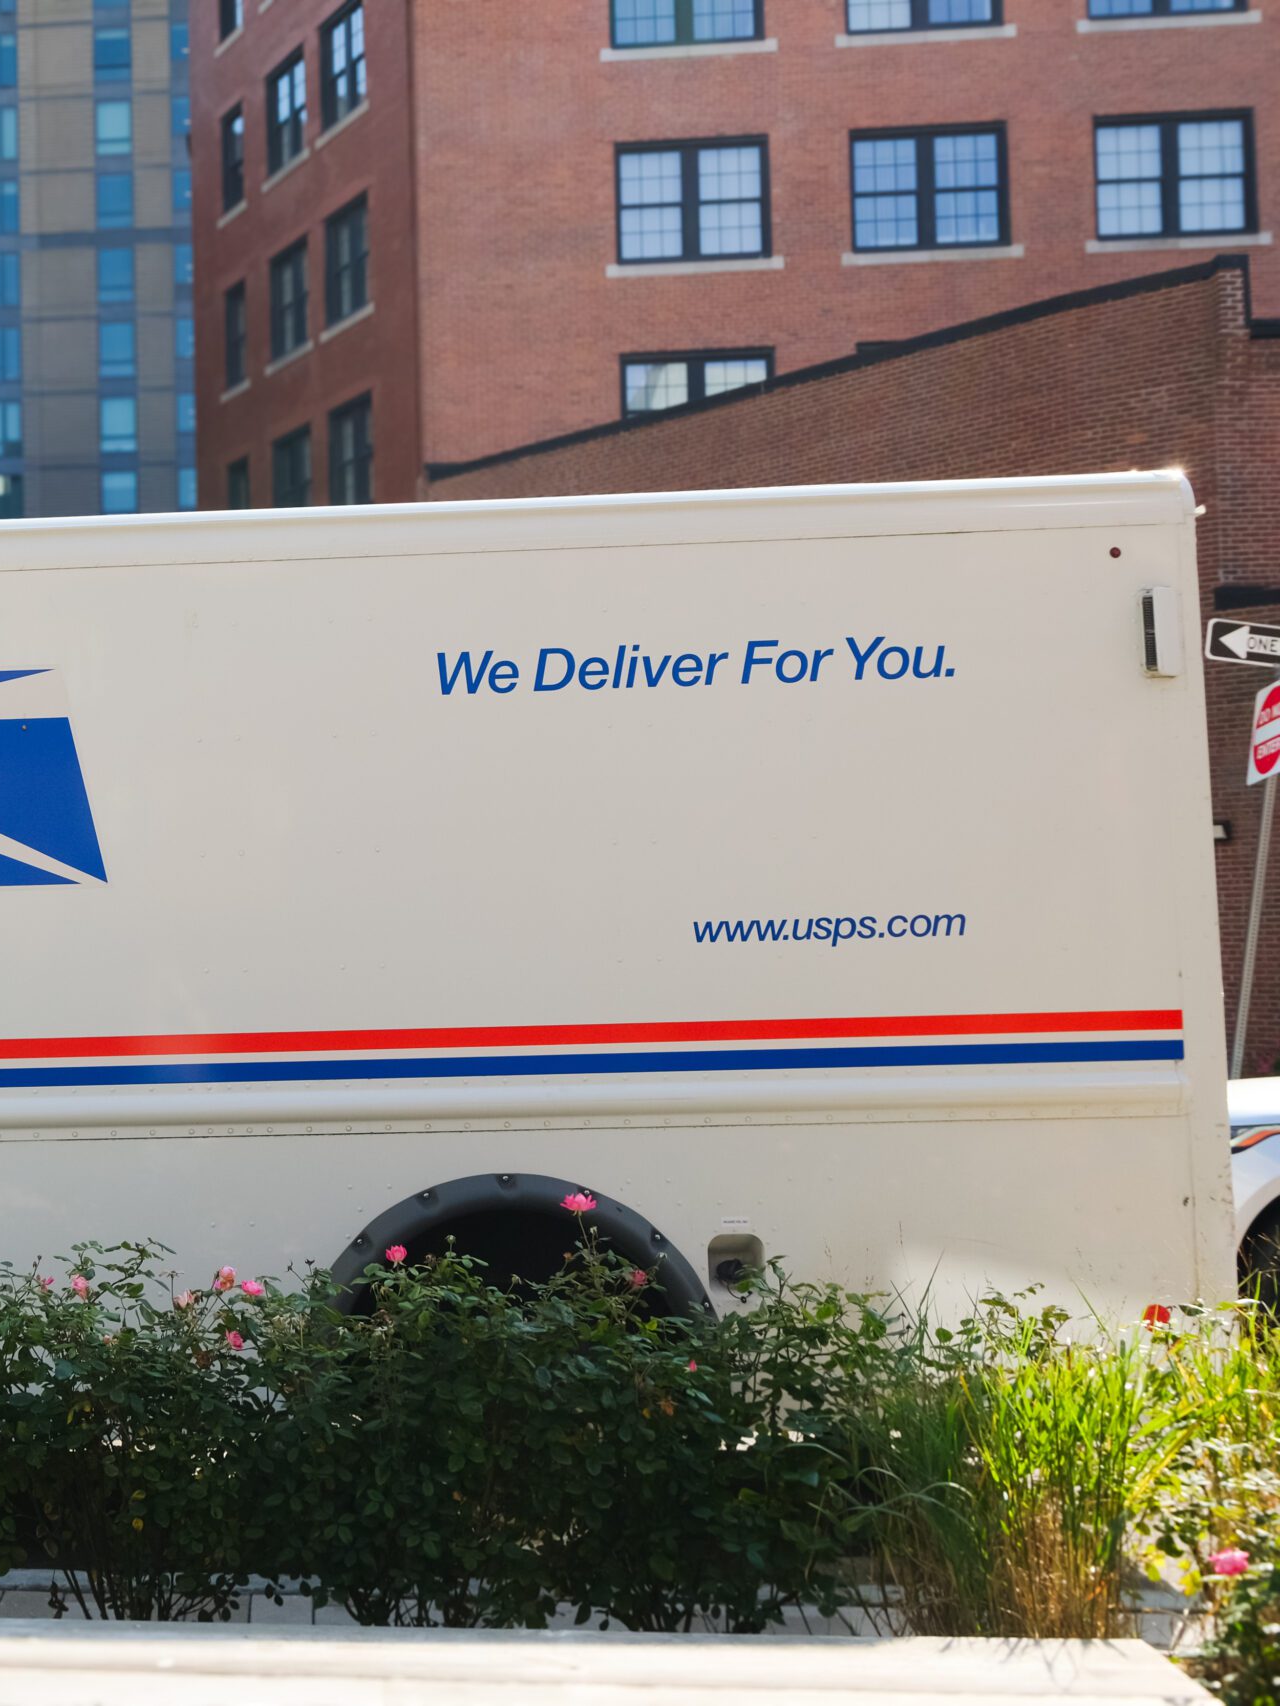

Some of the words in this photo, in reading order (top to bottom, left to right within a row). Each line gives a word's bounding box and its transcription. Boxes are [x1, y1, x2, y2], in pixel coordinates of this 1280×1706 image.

[1247, 636, 1278, 653] ONE
[436, 648, 521, 697] We
[532, 643, 730, 693] Deliver
[740, 639, 835, 686] For
[846, 635, 956, 682] You.
[692, 913, 967, 948] www.usps.com
